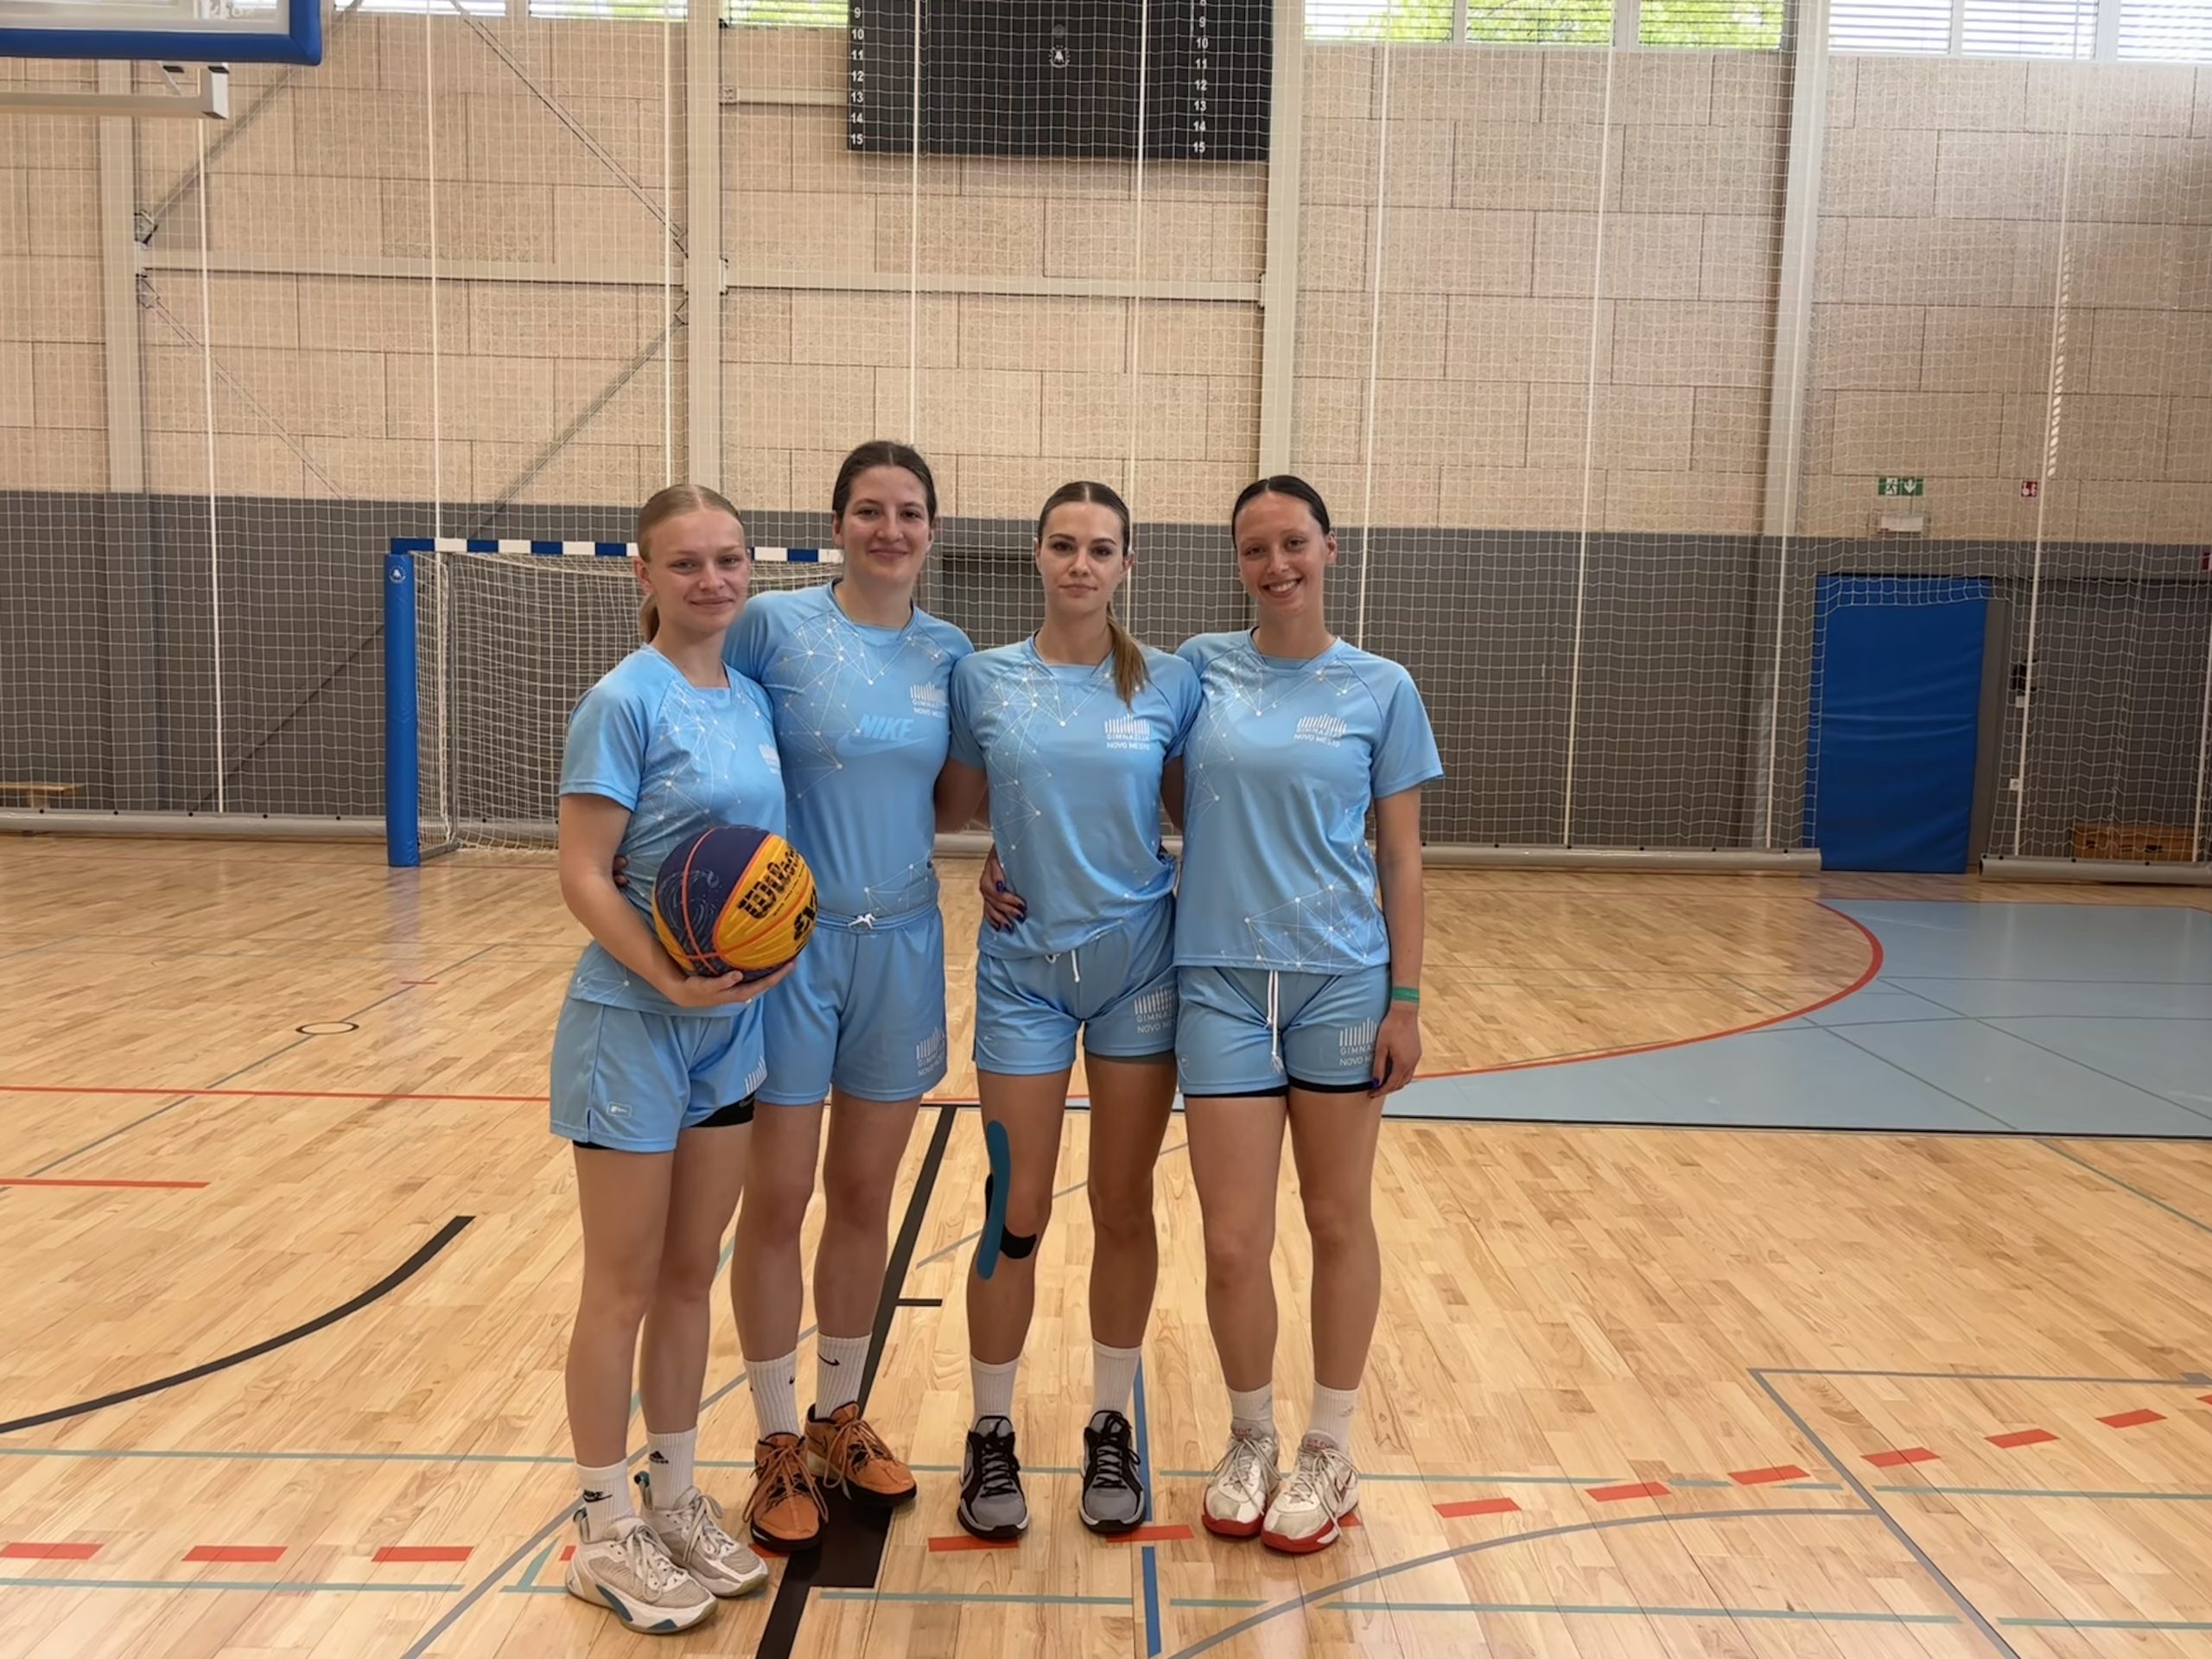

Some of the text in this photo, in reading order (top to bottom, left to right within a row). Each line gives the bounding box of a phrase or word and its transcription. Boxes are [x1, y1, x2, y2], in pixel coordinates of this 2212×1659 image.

[854, 7, 861, 18] 9
[1198, 16, 1206, 28] 9
[851, 29, 864, 40] 10
[1196, 37, 1208, 48] 10
[851, 49, 863, 60] 11
[1195, 58, 1207, 69] 11
[851, 71, 864, 82] 12
[1194, 79, 1207, 91] 12
[851, 92, 863, 103] 13
[1193, 100, 1206, 111] 13
[851, 112, 863, 124] 14
[1193, 121, 1205, 132] 14
[851, 133, 863, 145] 15
[1193, 142, 1205, 153] 15
[859, 714, 914, 741] NIKE
[1137, 1022, 1161, 1034] NOVO
[1340, 1056, 1363, 1066] NOVO
